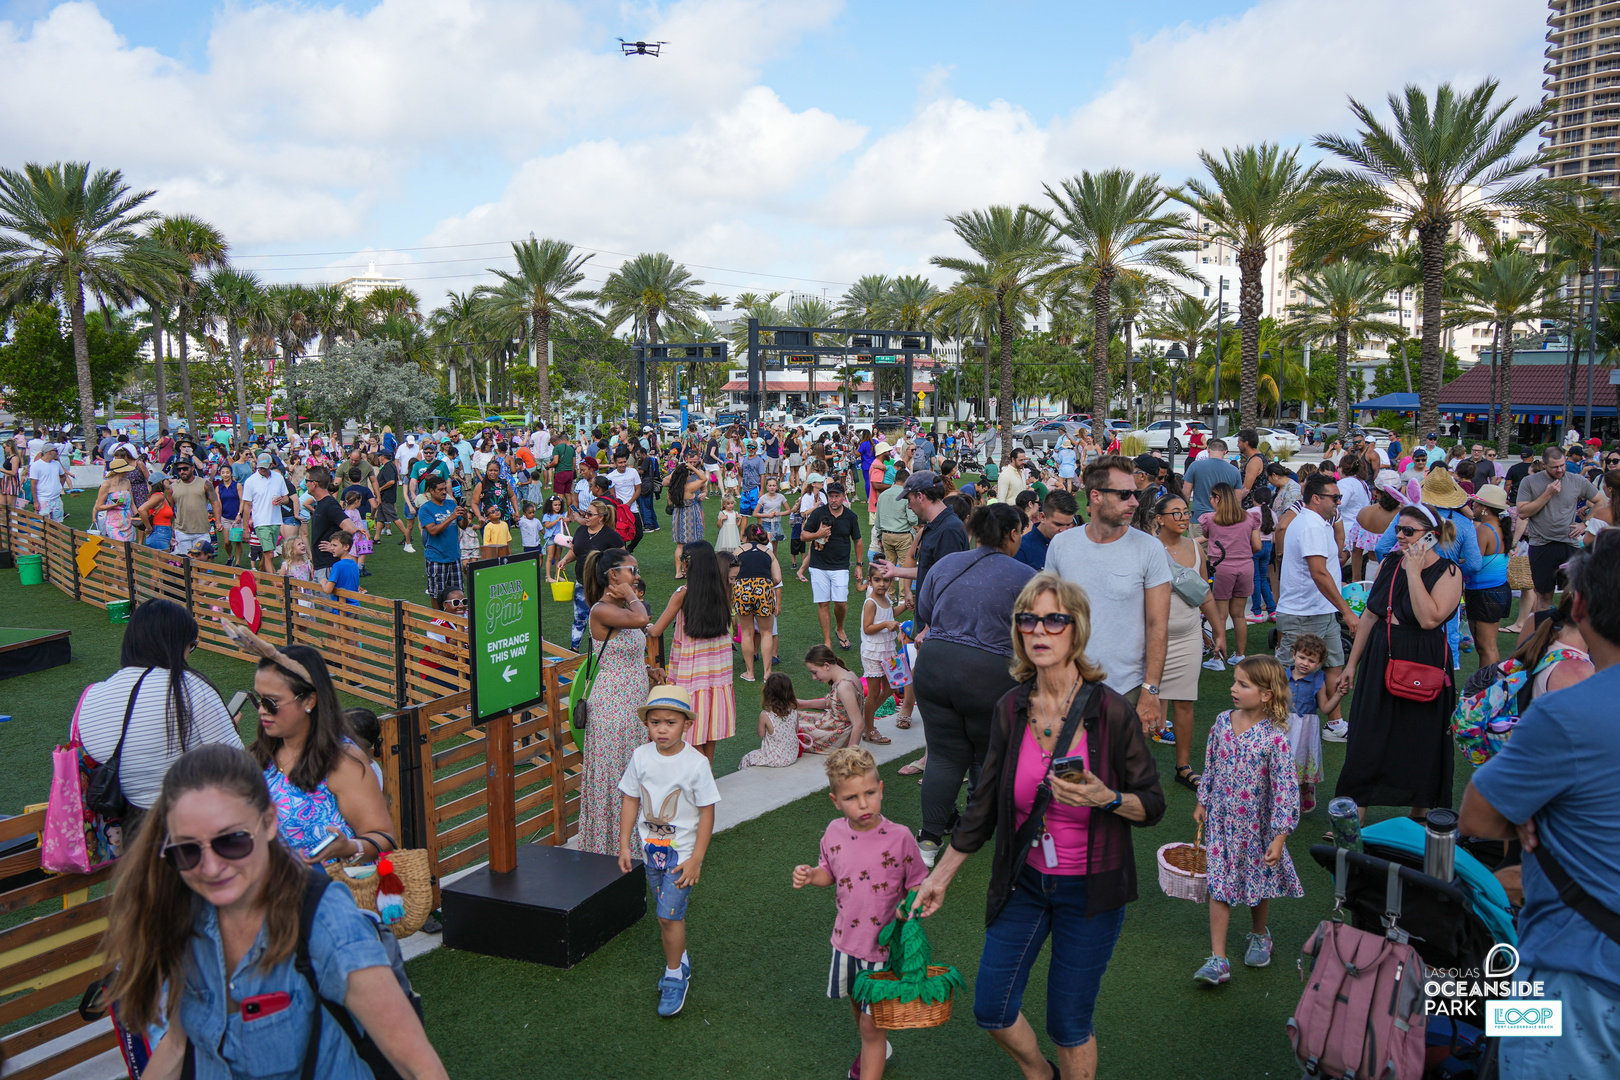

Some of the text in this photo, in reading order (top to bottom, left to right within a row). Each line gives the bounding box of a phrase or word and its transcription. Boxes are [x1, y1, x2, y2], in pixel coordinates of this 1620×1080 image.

[489, 580, 523, 598] PIXAR
[487, 632, 530, 653] ENTRANCE
[490, 645, 527, 664] THIS WAY
